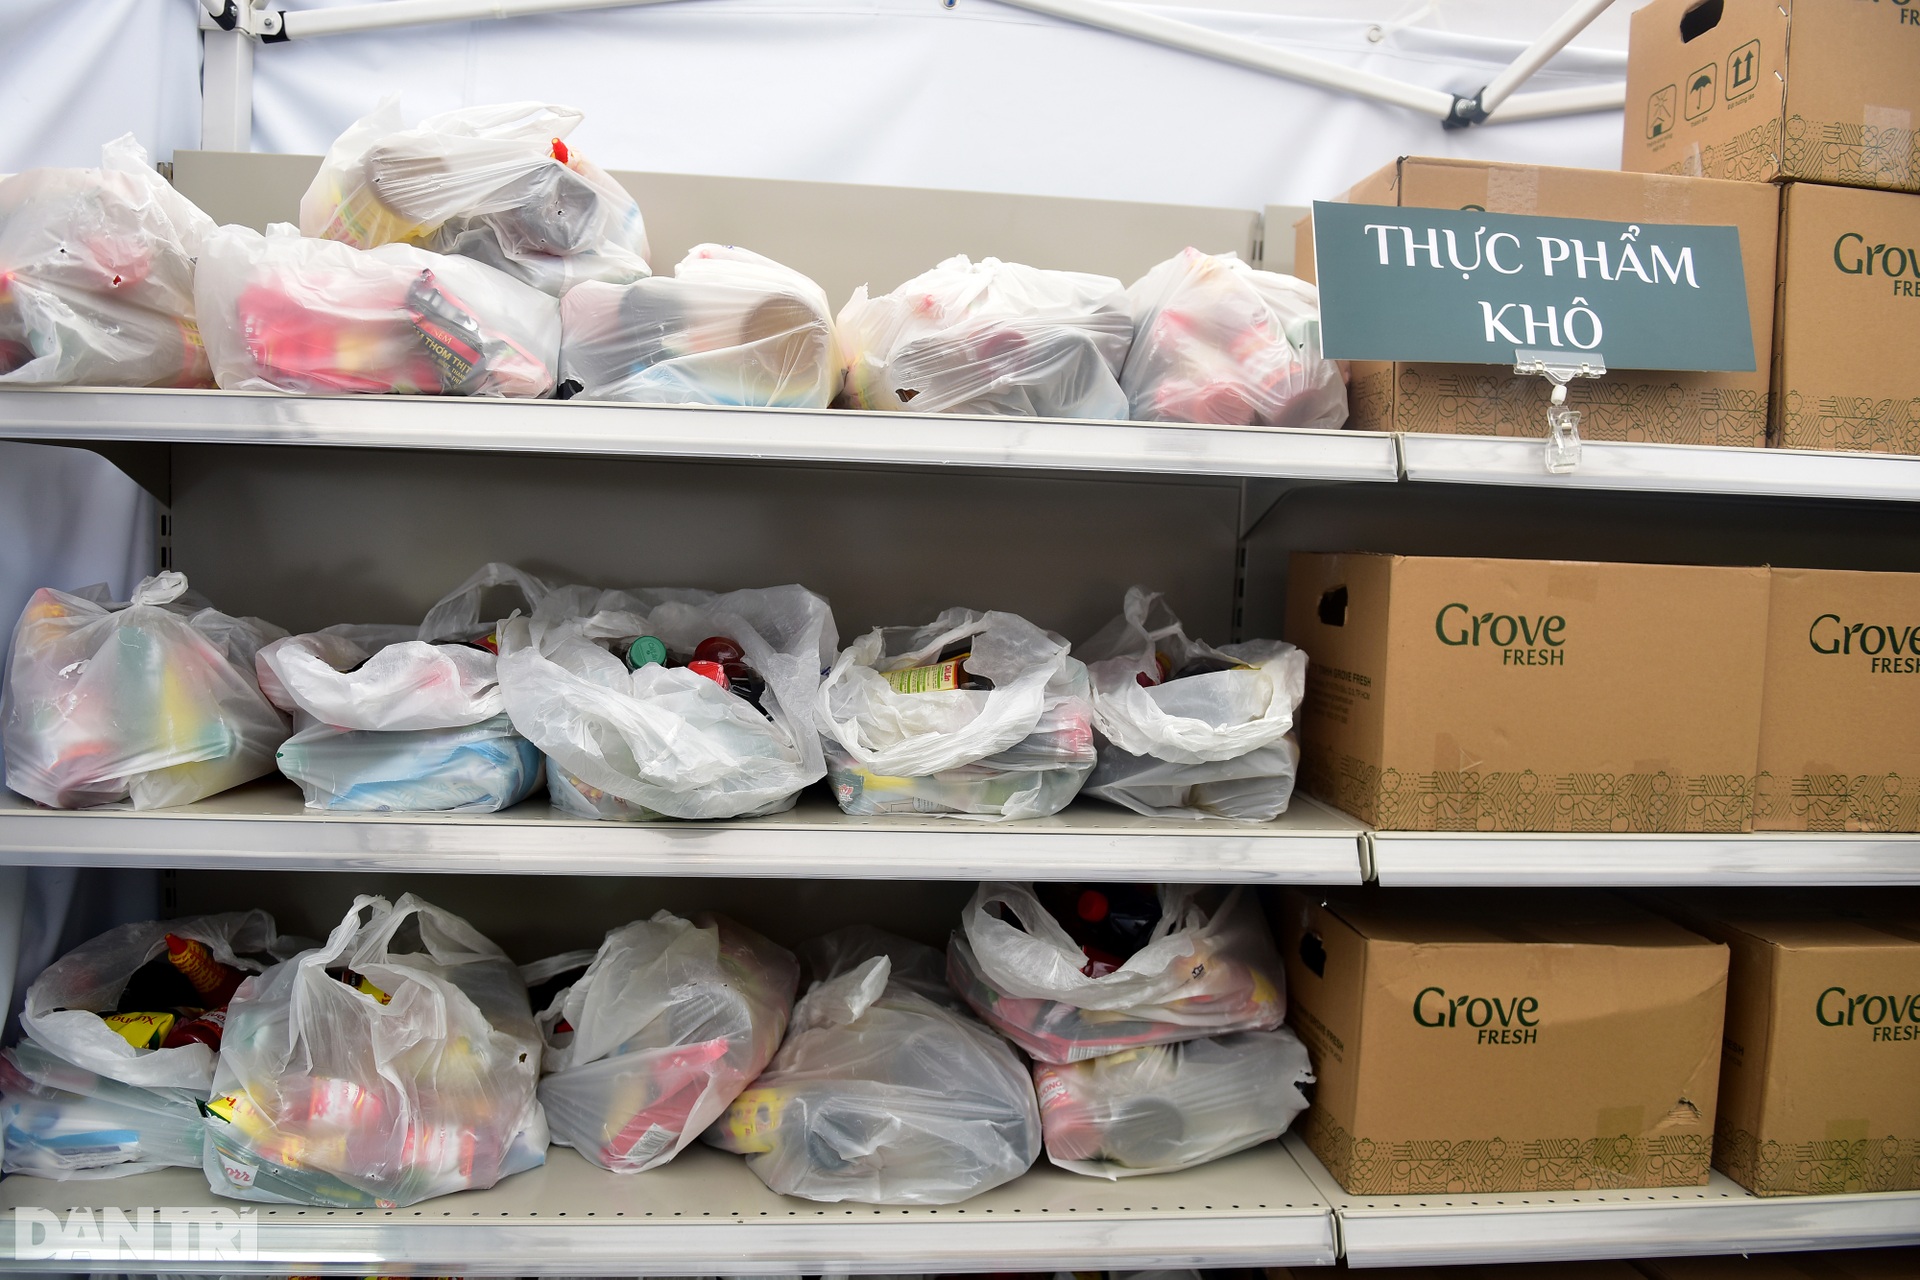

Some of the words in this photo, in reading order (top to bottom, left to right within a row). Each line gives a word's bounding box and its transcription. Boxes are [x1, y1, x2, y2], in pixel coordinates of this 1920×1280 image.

[1364, 223, 1524, 280] THỰC
[1536, 225, 1700, 289] PHẨM
[1478, 296, 1604, 350] KHÔ
[1435, 602, 1567, 646] Grove
[1503, 648, 1564, 666] FRESH
[1412, 986, 1540, 1028] Grove
[1477, 1029, 1538, 1045] FRESH
